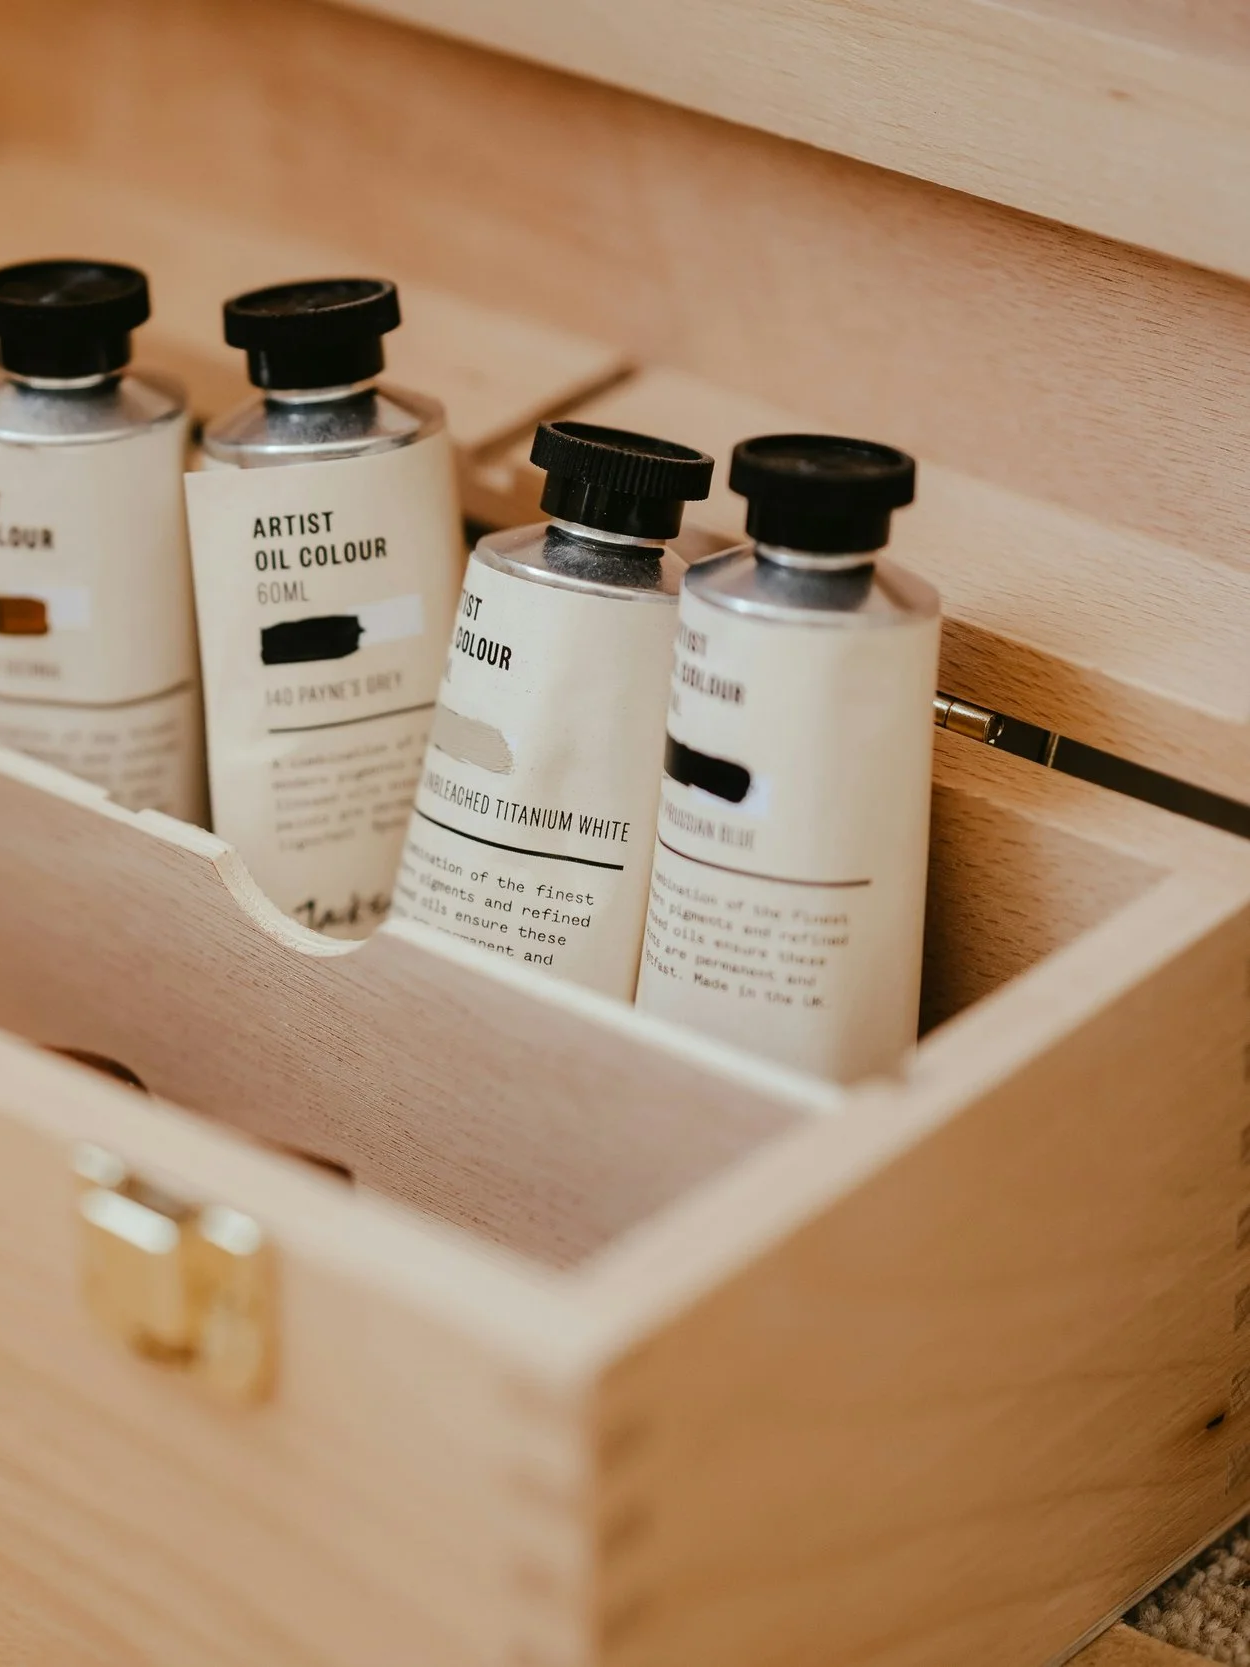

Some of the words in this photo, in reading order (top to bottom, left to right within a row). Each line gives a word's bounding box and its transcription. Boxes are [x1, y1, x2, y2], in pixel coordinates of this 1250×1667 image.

[253, 511, 334, 538] ARTIST
[255, 549, 291, 572] OIL
[299, 537, 388, 568] COLOUR
[256, 580, 310, 606] 60ML
[455, 626, 512, 671] COLOUR
[299, 677, 362, 704] PAYNE'S
[495, 798, 573, 833] TITANIUM
[579, 814, 632, 843] WHITE
[419, 873, 476, 904] pigments
[484, 896, 513, 914] and
[522, 905, 592, 929] refined
[470, 870, 489, 884] of
[497, 876, 526, 894] the
[536, 884, 595, 907] finest
[422, 895, 449, 917] oils
[455, 911, 509, 934] ensure
[518, 925, 567, 947] these
[669, 903, 733, 933] pigments
[743, 925, 772, 940] and
[724, 900, 745, 914] of
[753, 903, 783, 921] the
[523, 951, 554, 966] and
[672, 926, 705, 945] oils
[713, 940, 769, 959] ensure
[665, 944, 688, 961] are
[693, 954, 776, 983] permanent
[786, 973, 817, 988] and
[693, 972, 730, 992] Made
[738, 983, 757, 999] in
[764, 988, 794, 1006] the
